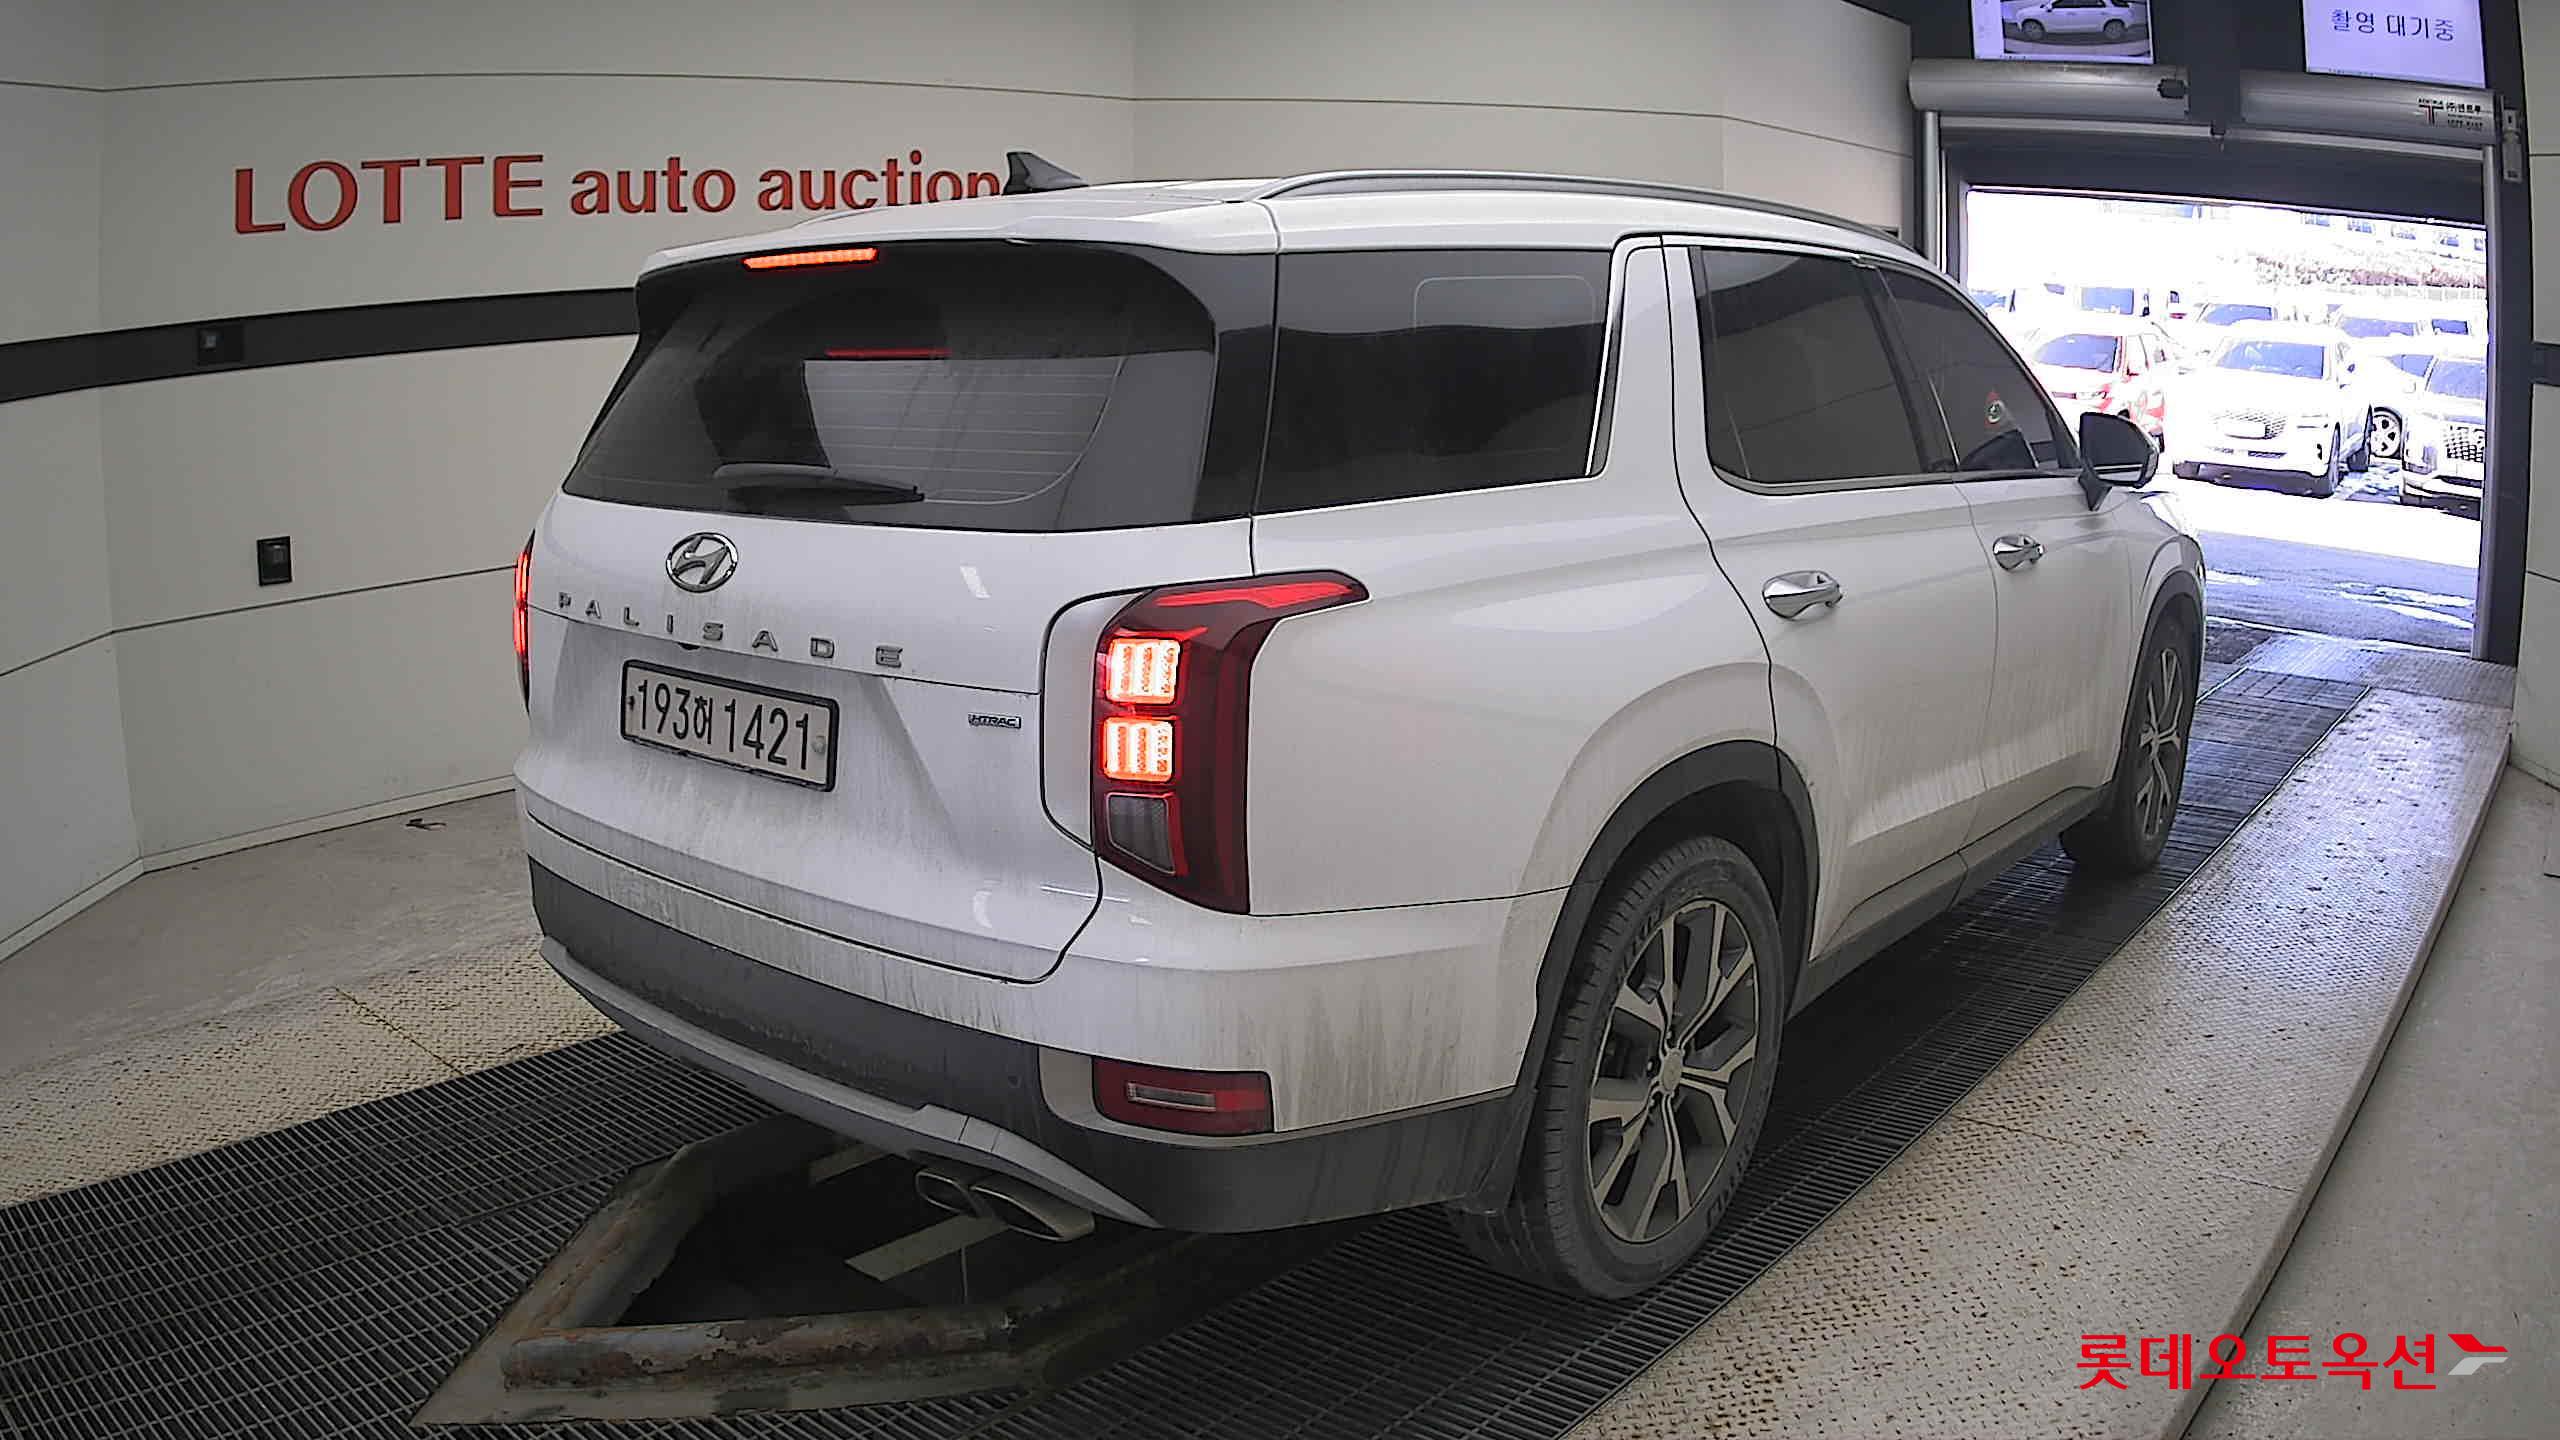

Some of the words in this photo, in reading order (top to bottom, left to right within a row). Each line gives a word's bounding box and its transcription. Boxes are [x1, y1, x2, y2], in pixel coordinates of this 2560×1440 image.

[2331, 9, 2375, 34] 촬영
[2386, 14, 2454, 42] 대기중
[234, 154, 543, 234] LOTTE
[570, 156, 736, 215] auto
[757, 150, 1001, 212] auction
[558, 592, 904, 668] PALISADE
